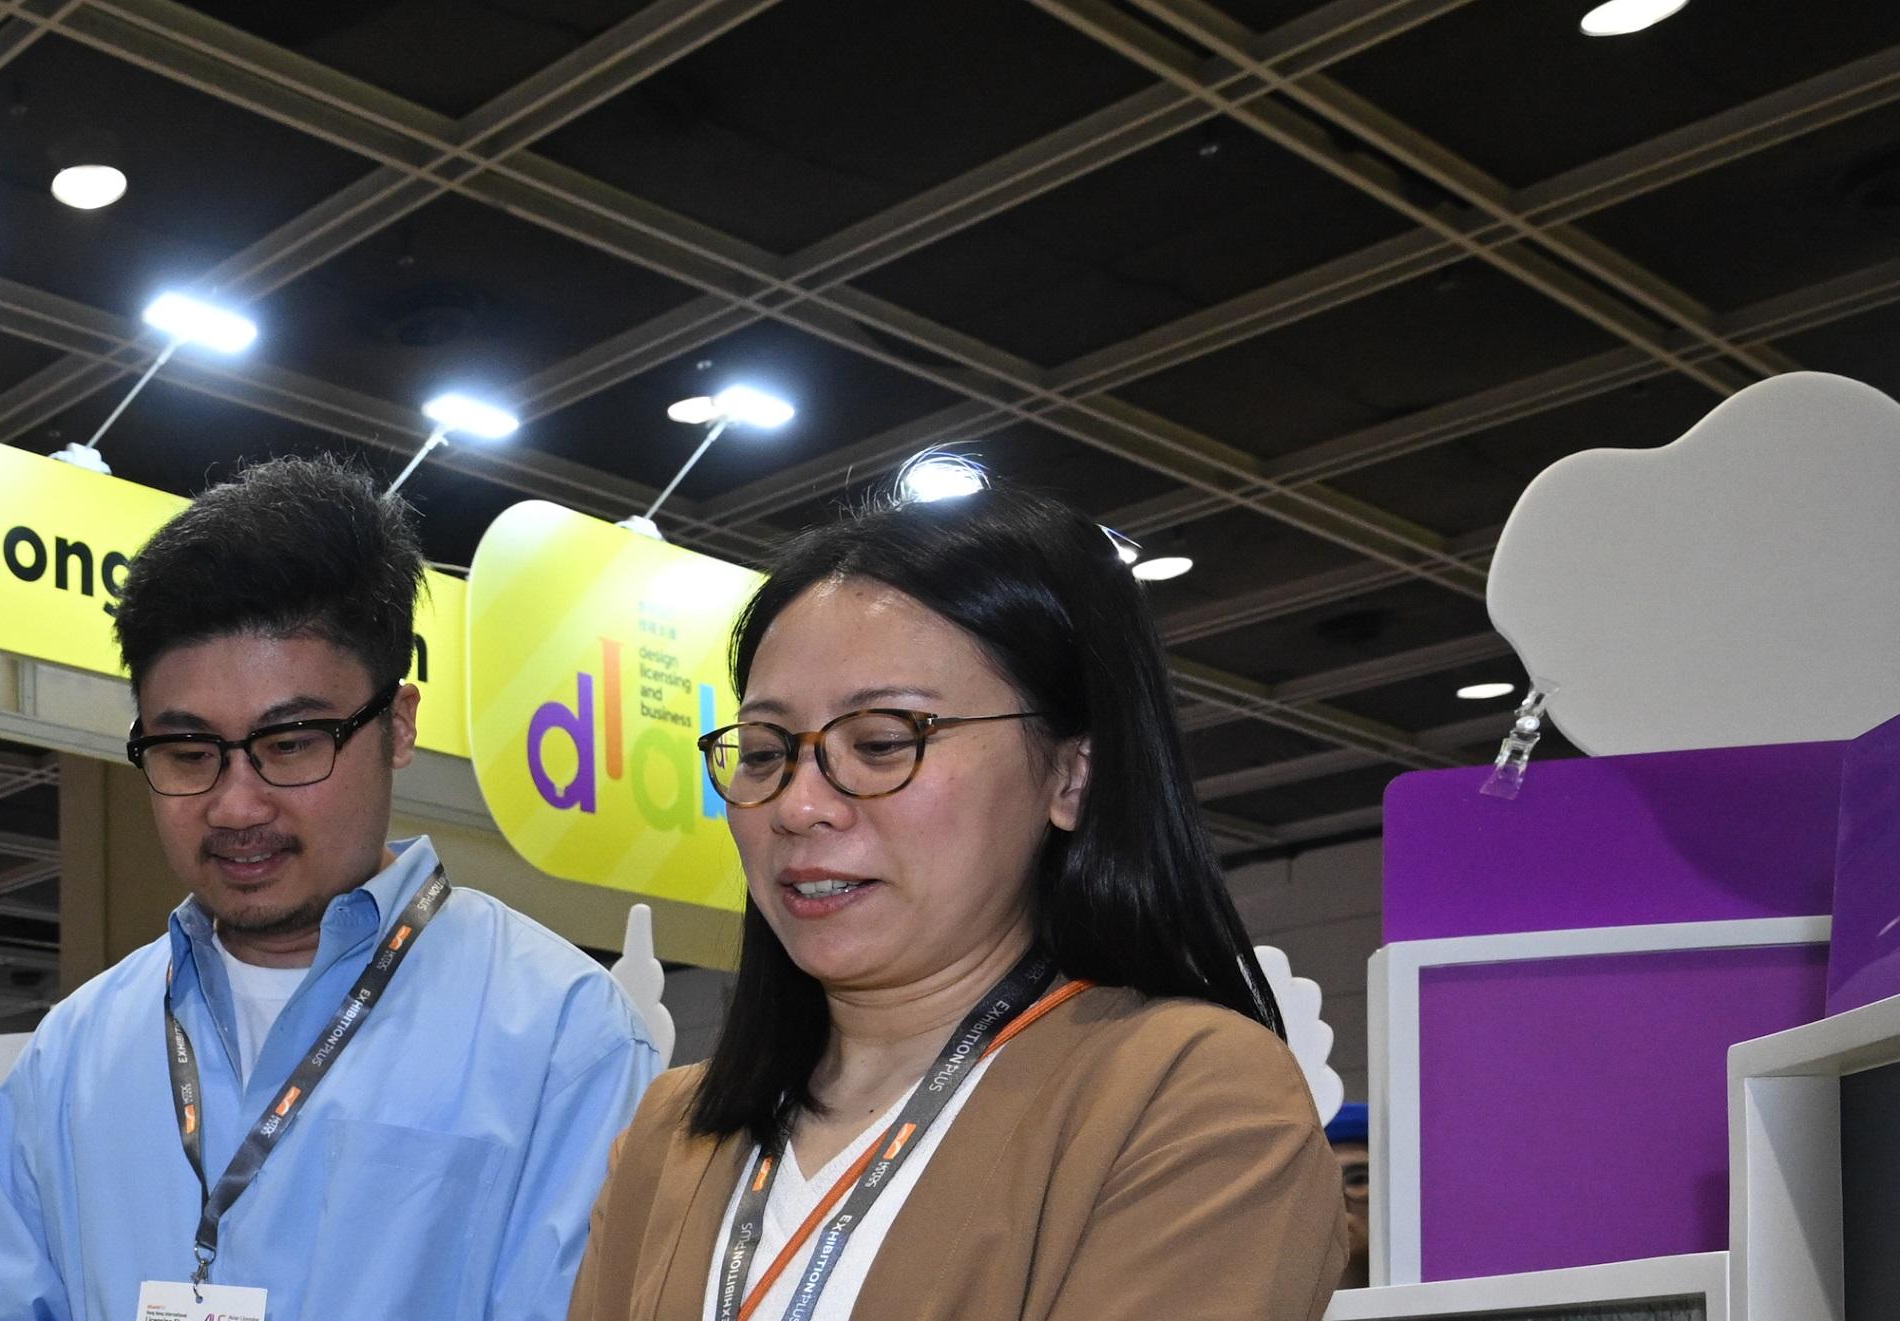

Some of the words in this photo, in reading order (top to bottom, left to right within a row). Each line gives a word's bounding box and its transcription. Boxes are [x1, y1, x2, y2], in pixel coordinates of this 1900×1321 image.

[638, 646, 678, 668] design
[638, 664, 692, 694] licensing
[639, 684, 663, 702] and
[640, 701, 693, 728] business
